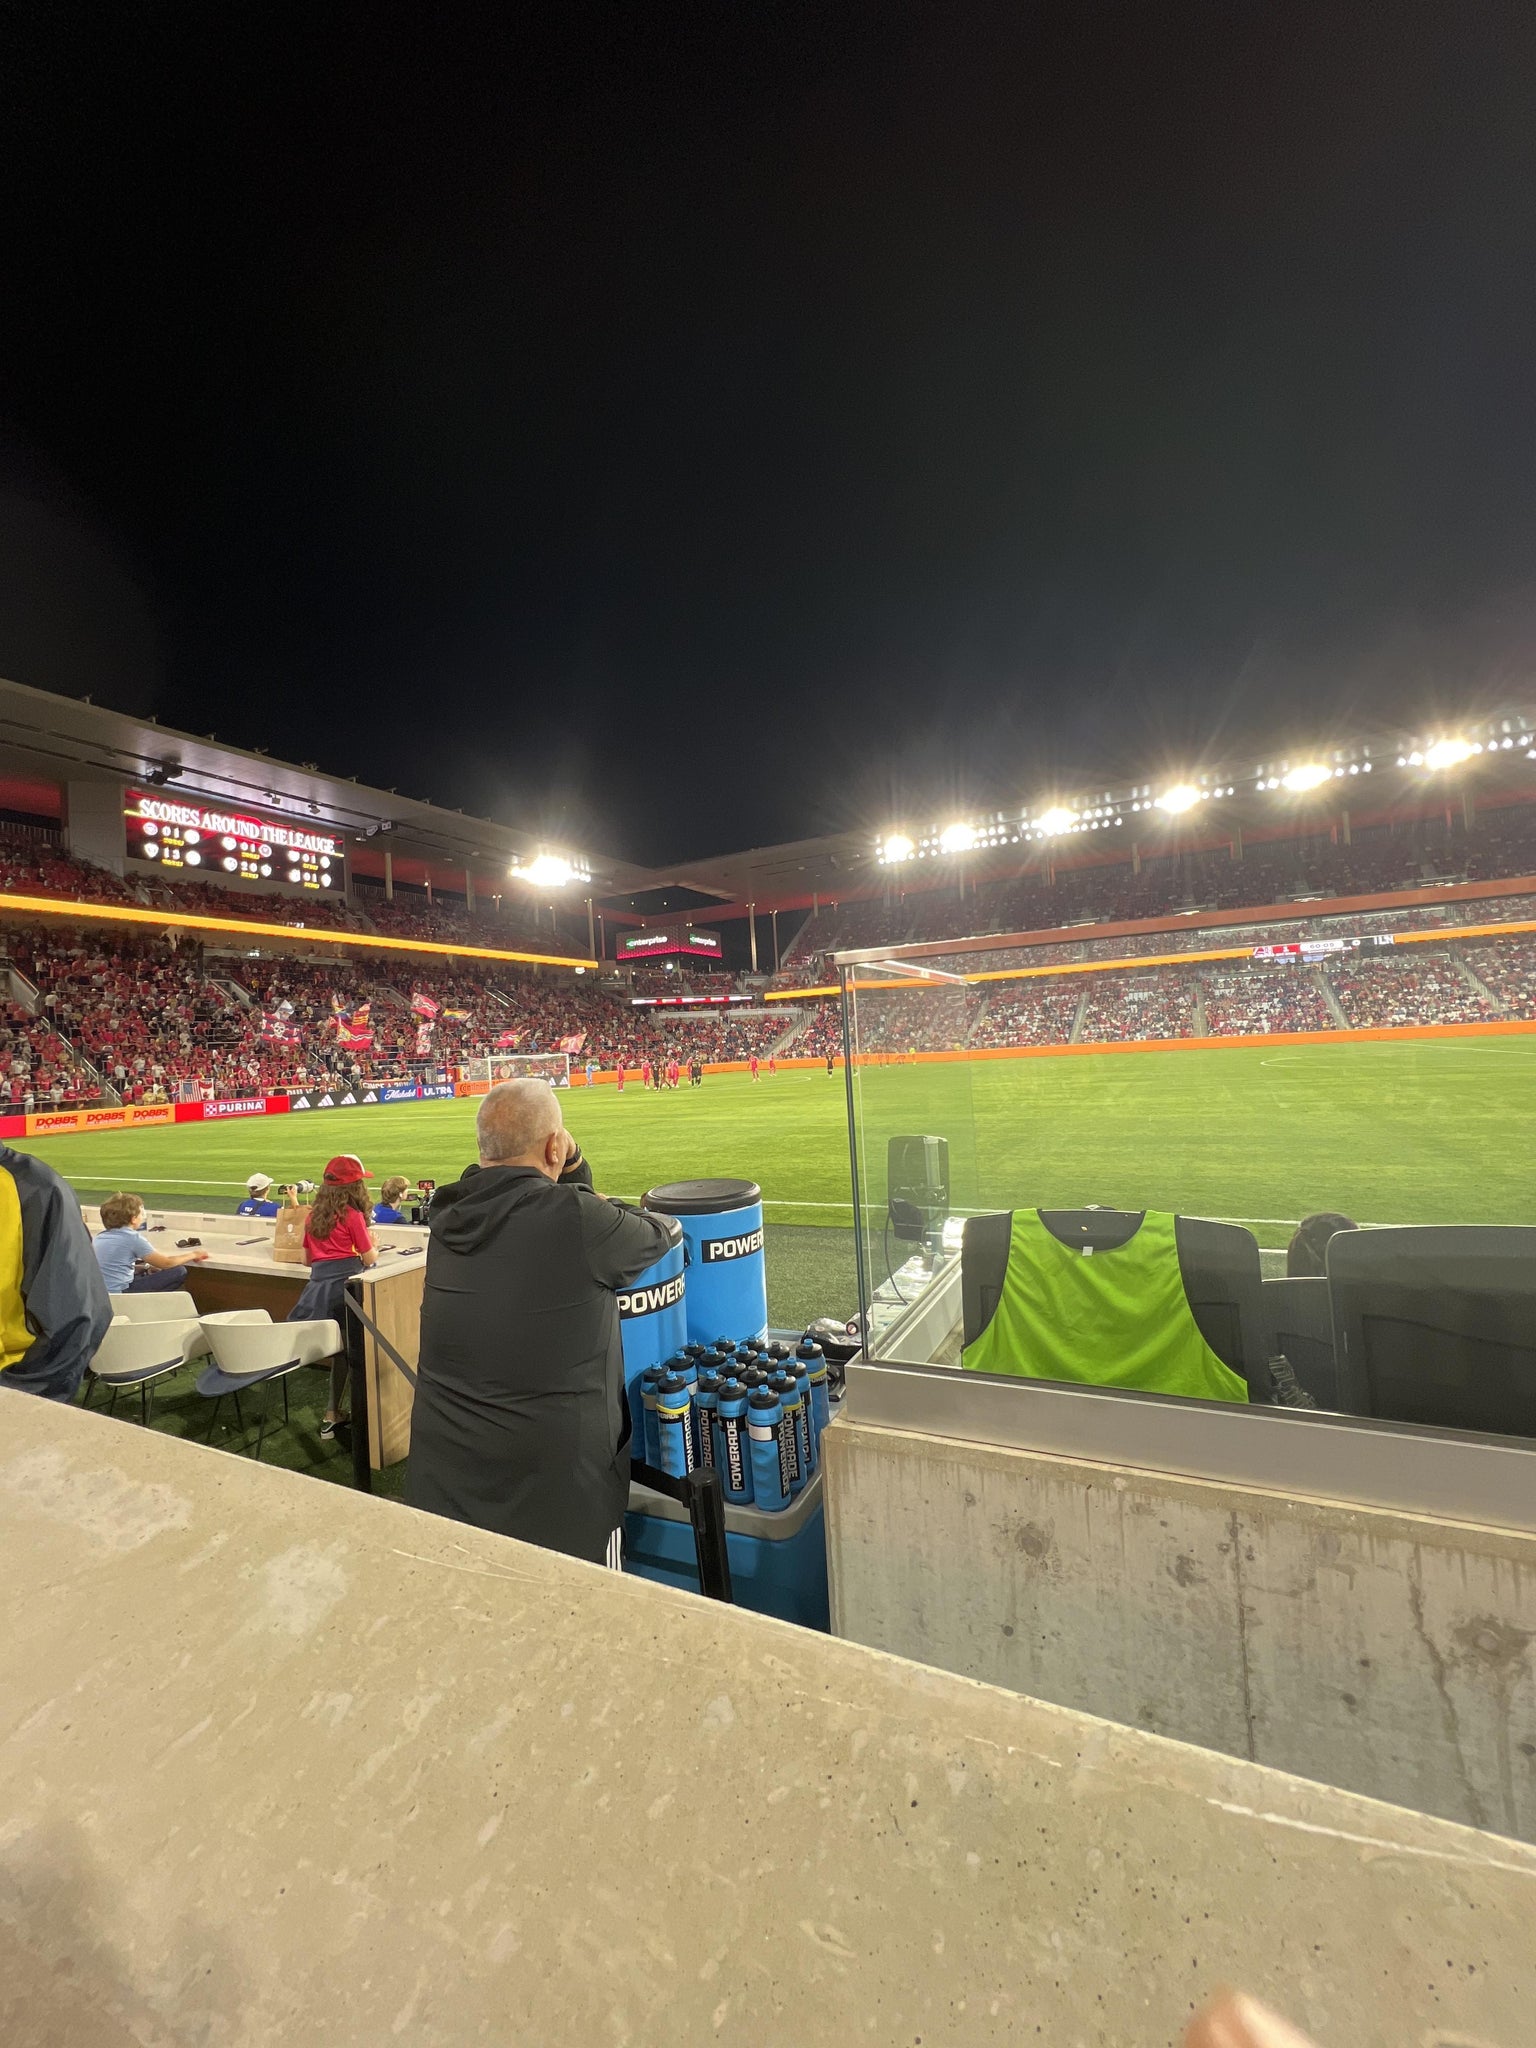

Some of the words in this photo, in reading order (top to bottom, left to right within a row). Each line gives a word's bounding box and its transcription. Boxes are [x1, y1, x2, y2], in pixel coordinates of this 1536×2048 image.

[139, 798, 200, 827] SCORES
[201, 813, 260, 839] AROUND
[260, 825, 288, 846] THE
[288, 831, 336, 856] LEAUGE
[626, 935, 668, 948] enterprise
[423, 1085, 453, 1097] ULTRA
[133, 1107, 169, 1119] DOBBS
[218, 1101, 263, 1114] PURINA
[36, 1115, 78, 1127] DOBBS
[86, 1111, 125, 1123] DOBBS
[726, 1419, 743, 1490] POWERADE
[777, 1422, 790, 1494] POWERADE
